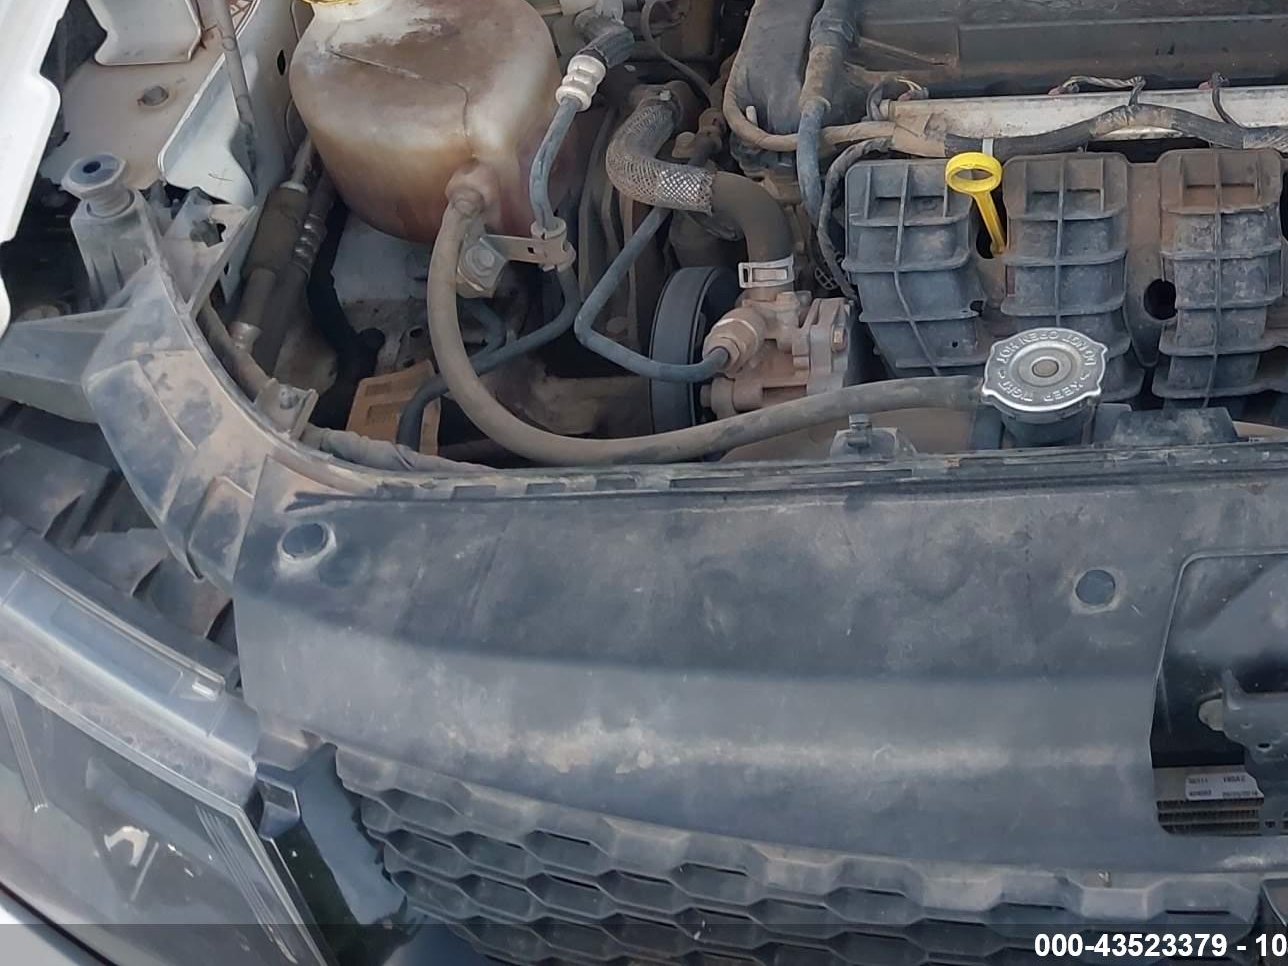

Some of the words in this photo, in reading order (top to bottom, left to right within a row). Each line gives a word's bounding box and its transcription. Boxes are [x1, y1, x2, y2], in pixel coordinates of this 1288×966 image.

[1018, 331, 1059, 345] OPEN
[996, 342, 1019, 364] HOT
[1043, 381, 1084, 402] KEEP
